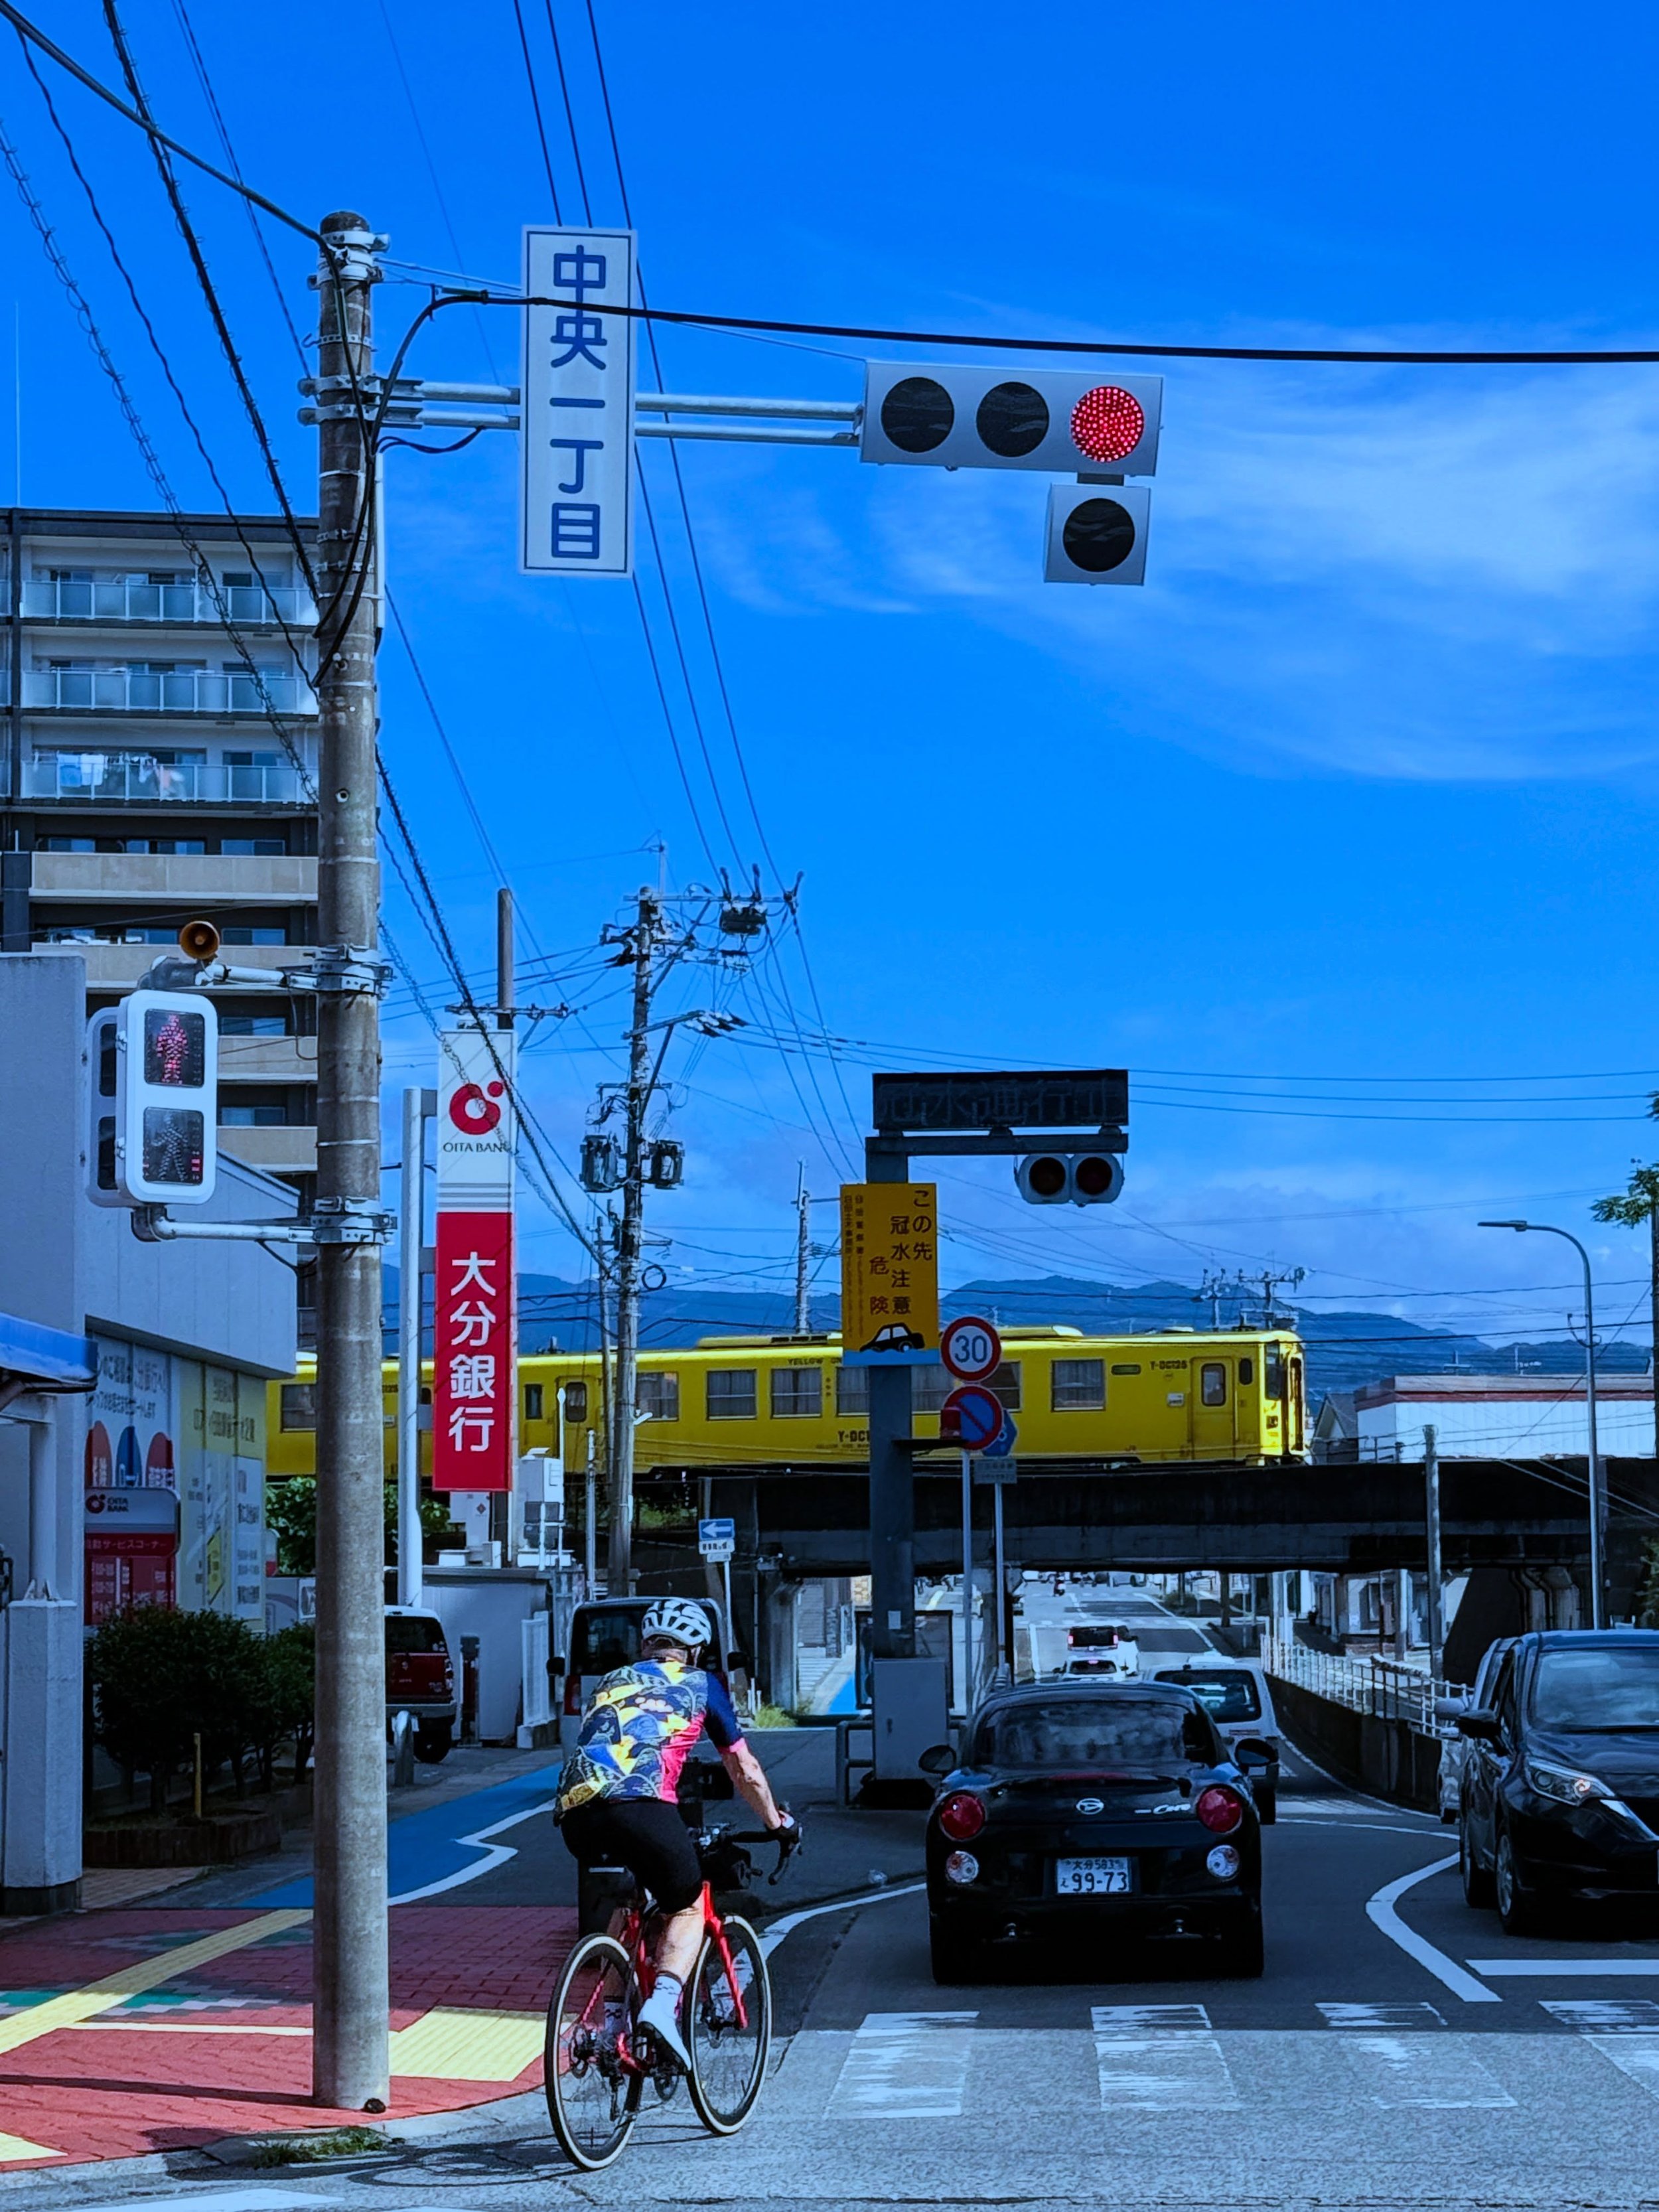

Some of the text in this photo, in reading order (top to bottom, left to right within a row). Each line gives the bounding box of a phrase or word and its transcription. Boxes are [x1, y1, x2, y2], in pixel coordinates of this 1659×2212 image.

[549, 244, 608, 559] 中央一丁目
[443, 1142, 473, 1153] OITA
[912, 1189, 932, 1261] この先
[869, 1256, 890, 1315] 危険
[890, 1215, 912, 1315] 冠水注意
[449, 1251, 496, 1452] 大分銀行
[954, 1335, 987, 1363] 30
[1072, 1872, 1127, 1892] 99-73
